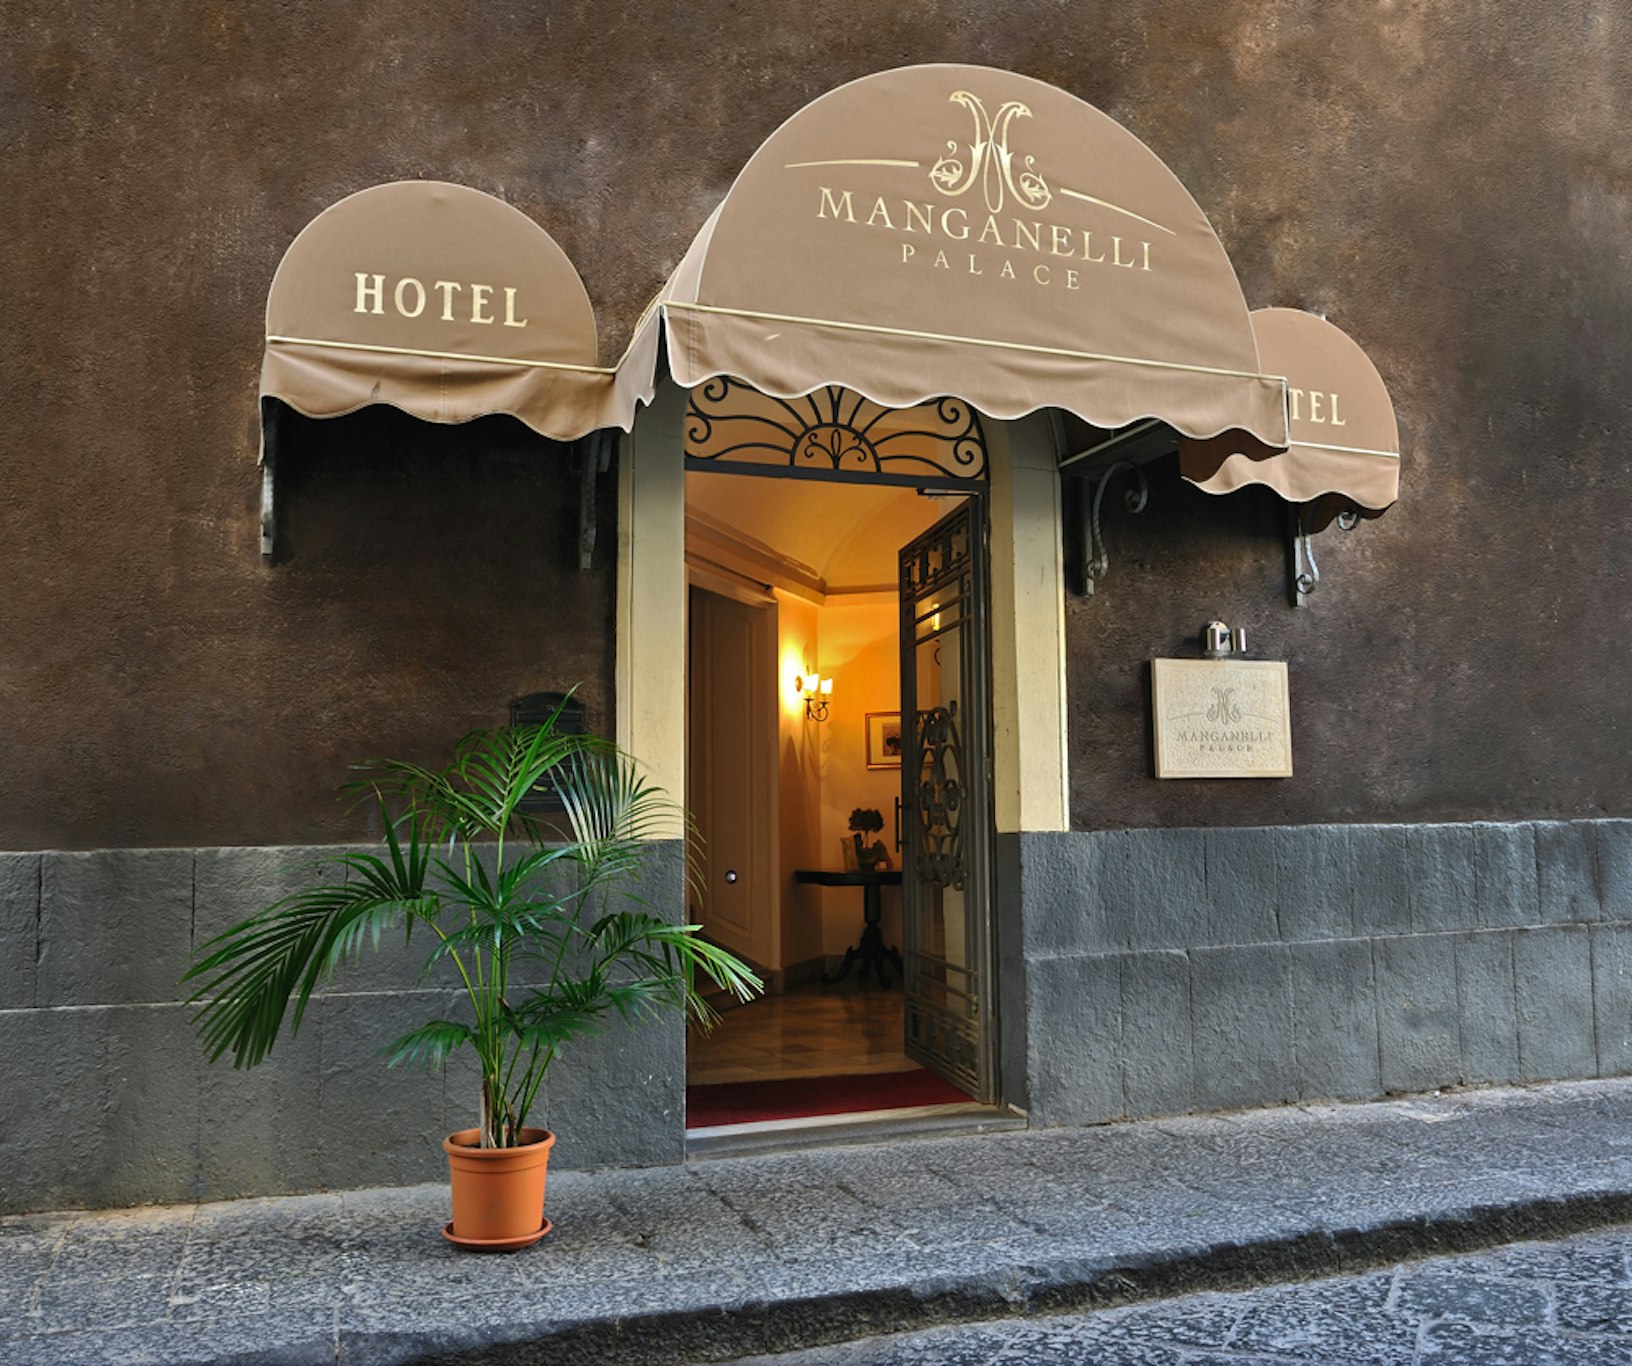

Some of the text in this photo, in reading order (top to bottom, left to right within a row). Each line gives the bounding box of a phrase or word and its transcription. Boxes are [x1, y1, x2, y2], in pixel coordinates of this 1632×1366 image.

[816, 186, 1153, 272] MANGANELLI
[902, 243, 1080, 290] PALACE
[353, 272, 528, 328] HOTEL
[1176, 730, 1273, 743] MANGANELLI
